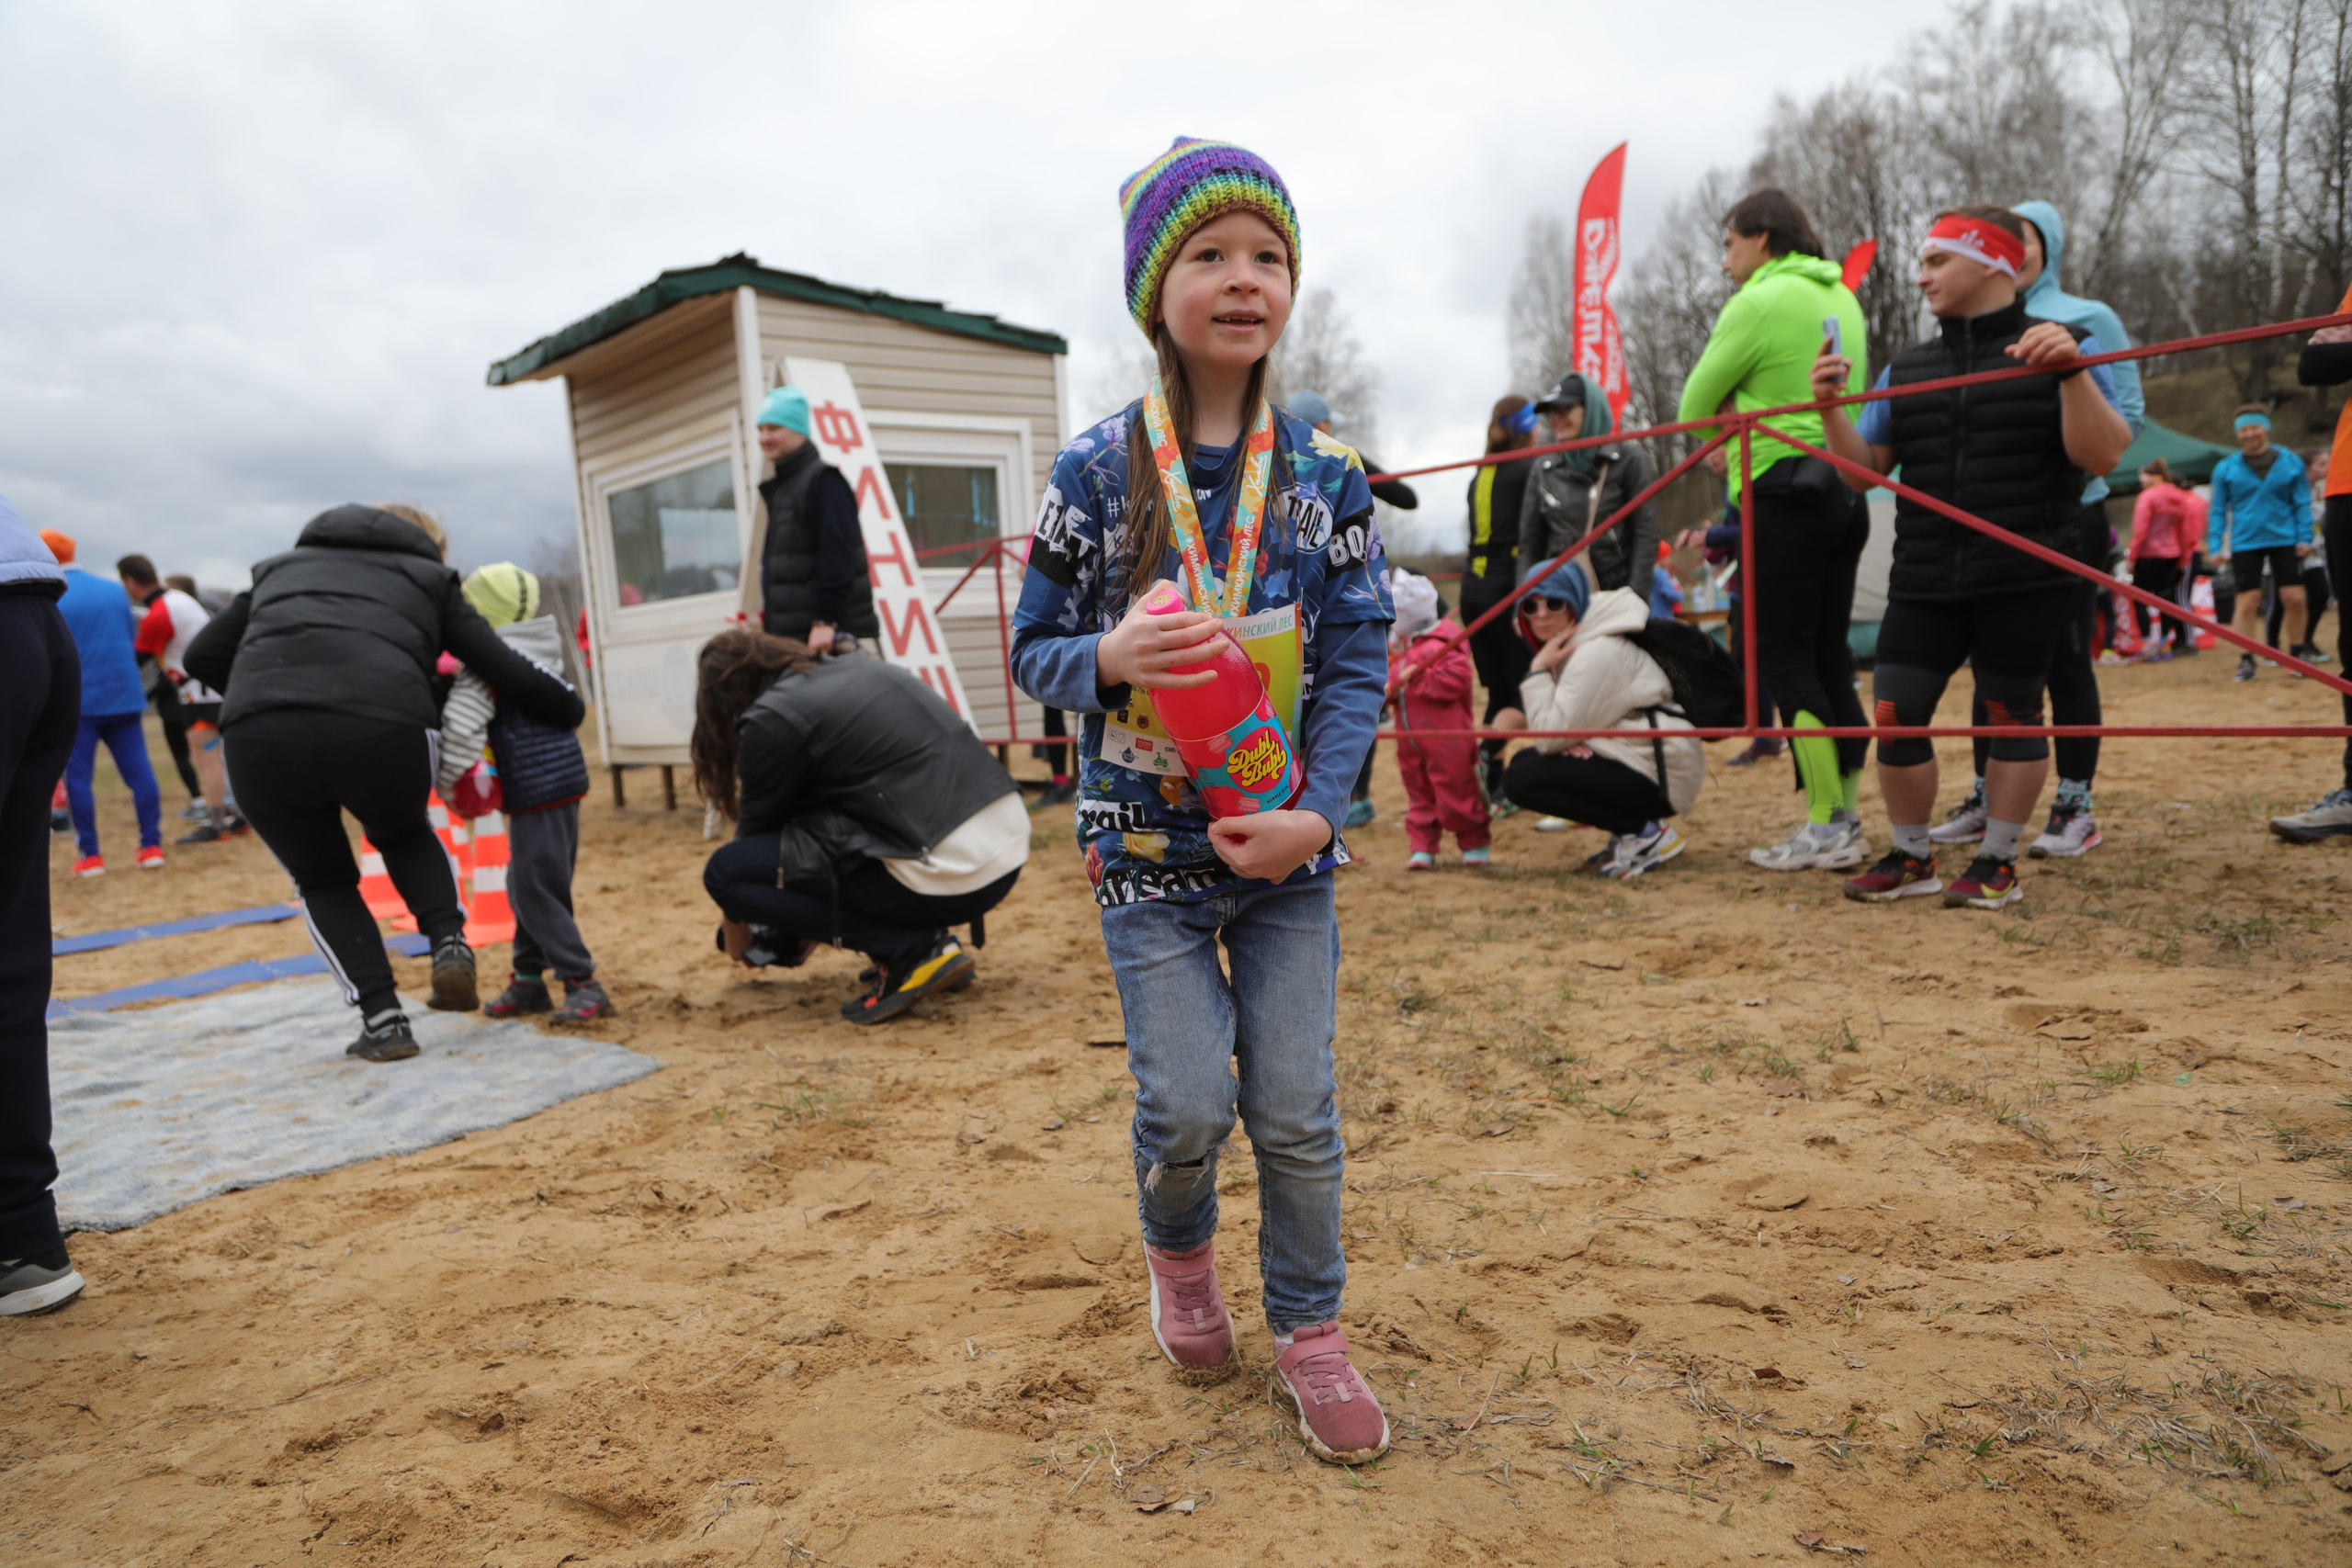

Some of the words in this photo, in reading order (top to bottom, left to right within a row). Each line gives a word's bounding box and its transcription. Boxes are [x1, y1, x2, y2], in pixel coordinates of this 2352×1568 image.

[1244, 515, 1256, 537] ЛЕС
[1278, 615, 1293, 631] ЛЕС
[1227, 728, 1276, 774] Dubl
[1241, 741, 1287, 787] Bubl
